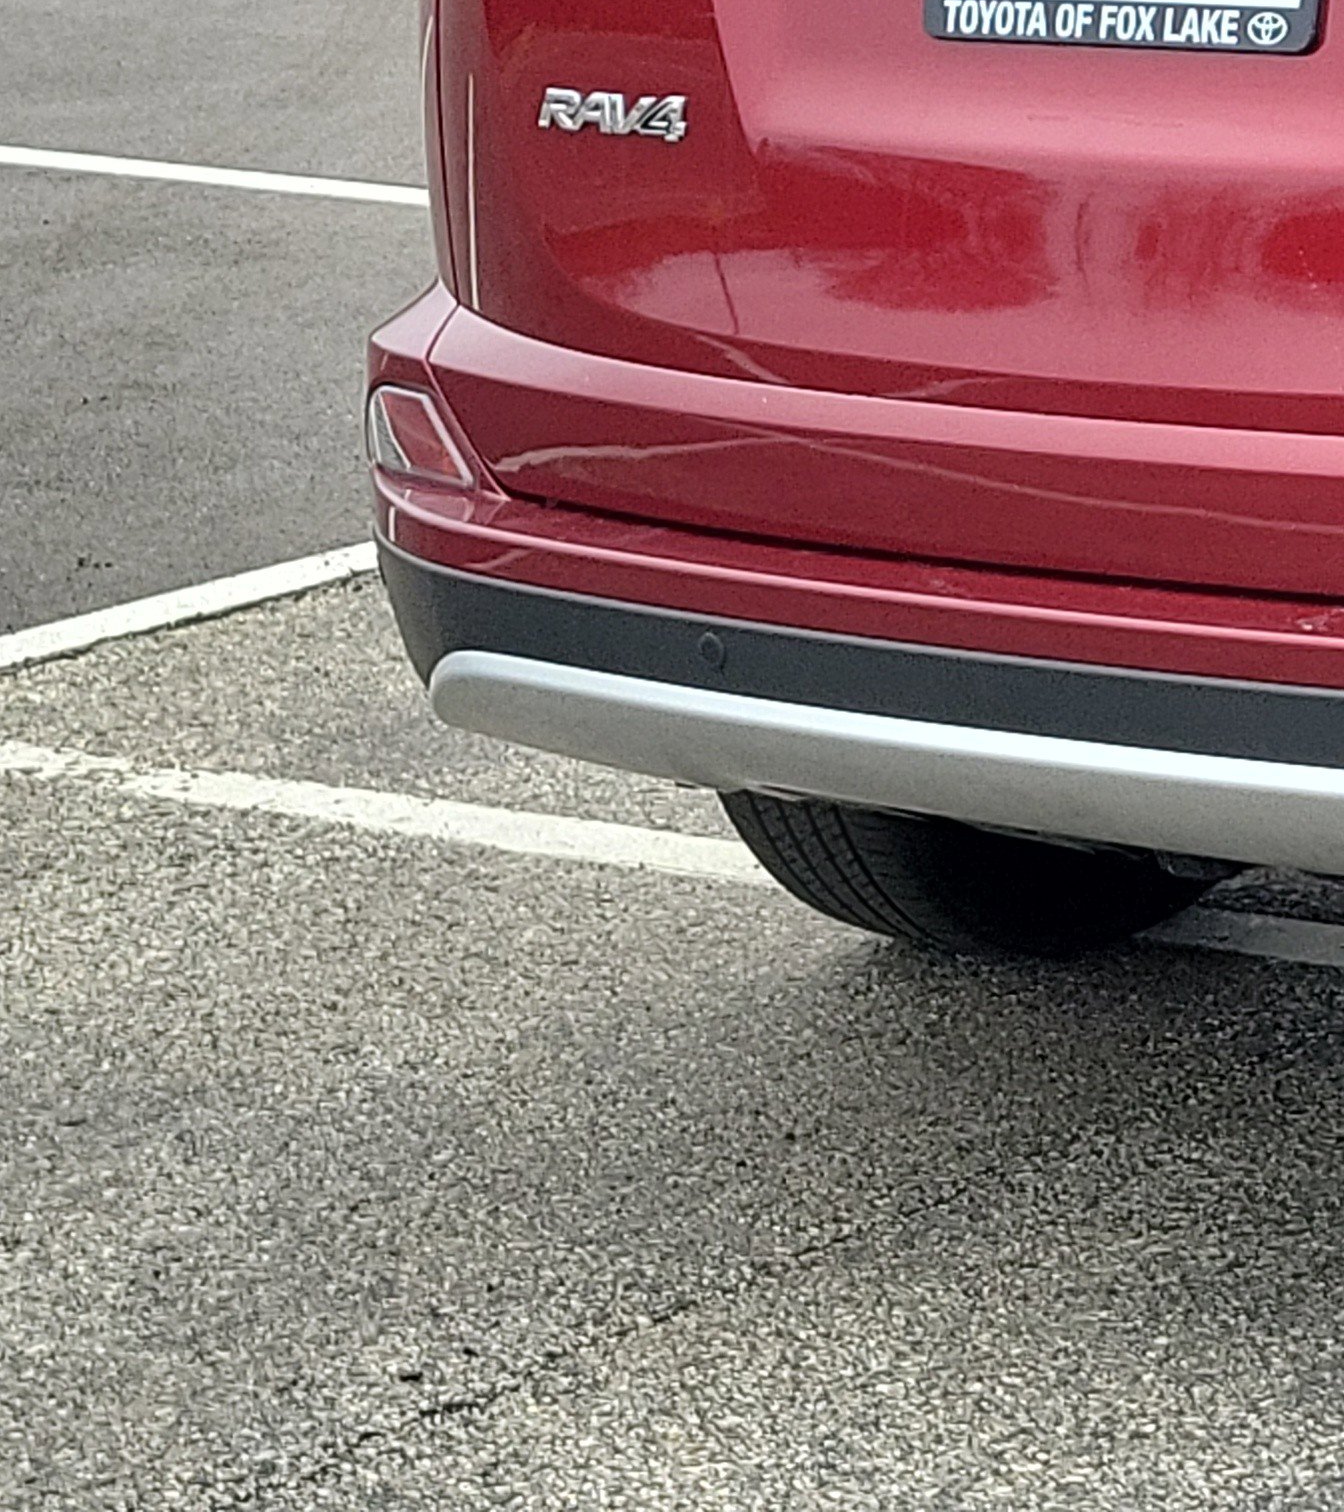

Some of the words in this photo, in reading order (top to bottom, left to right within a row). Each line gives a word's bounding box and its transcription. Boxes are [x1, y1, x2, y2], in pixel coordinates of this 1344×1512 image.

[1055, 3, 1095, 38] OF
[1098, 5, 1155, 41] FOX
[1162, 8, 1241, 45] LAKE
[537, 86, 688, 143] RAV4
